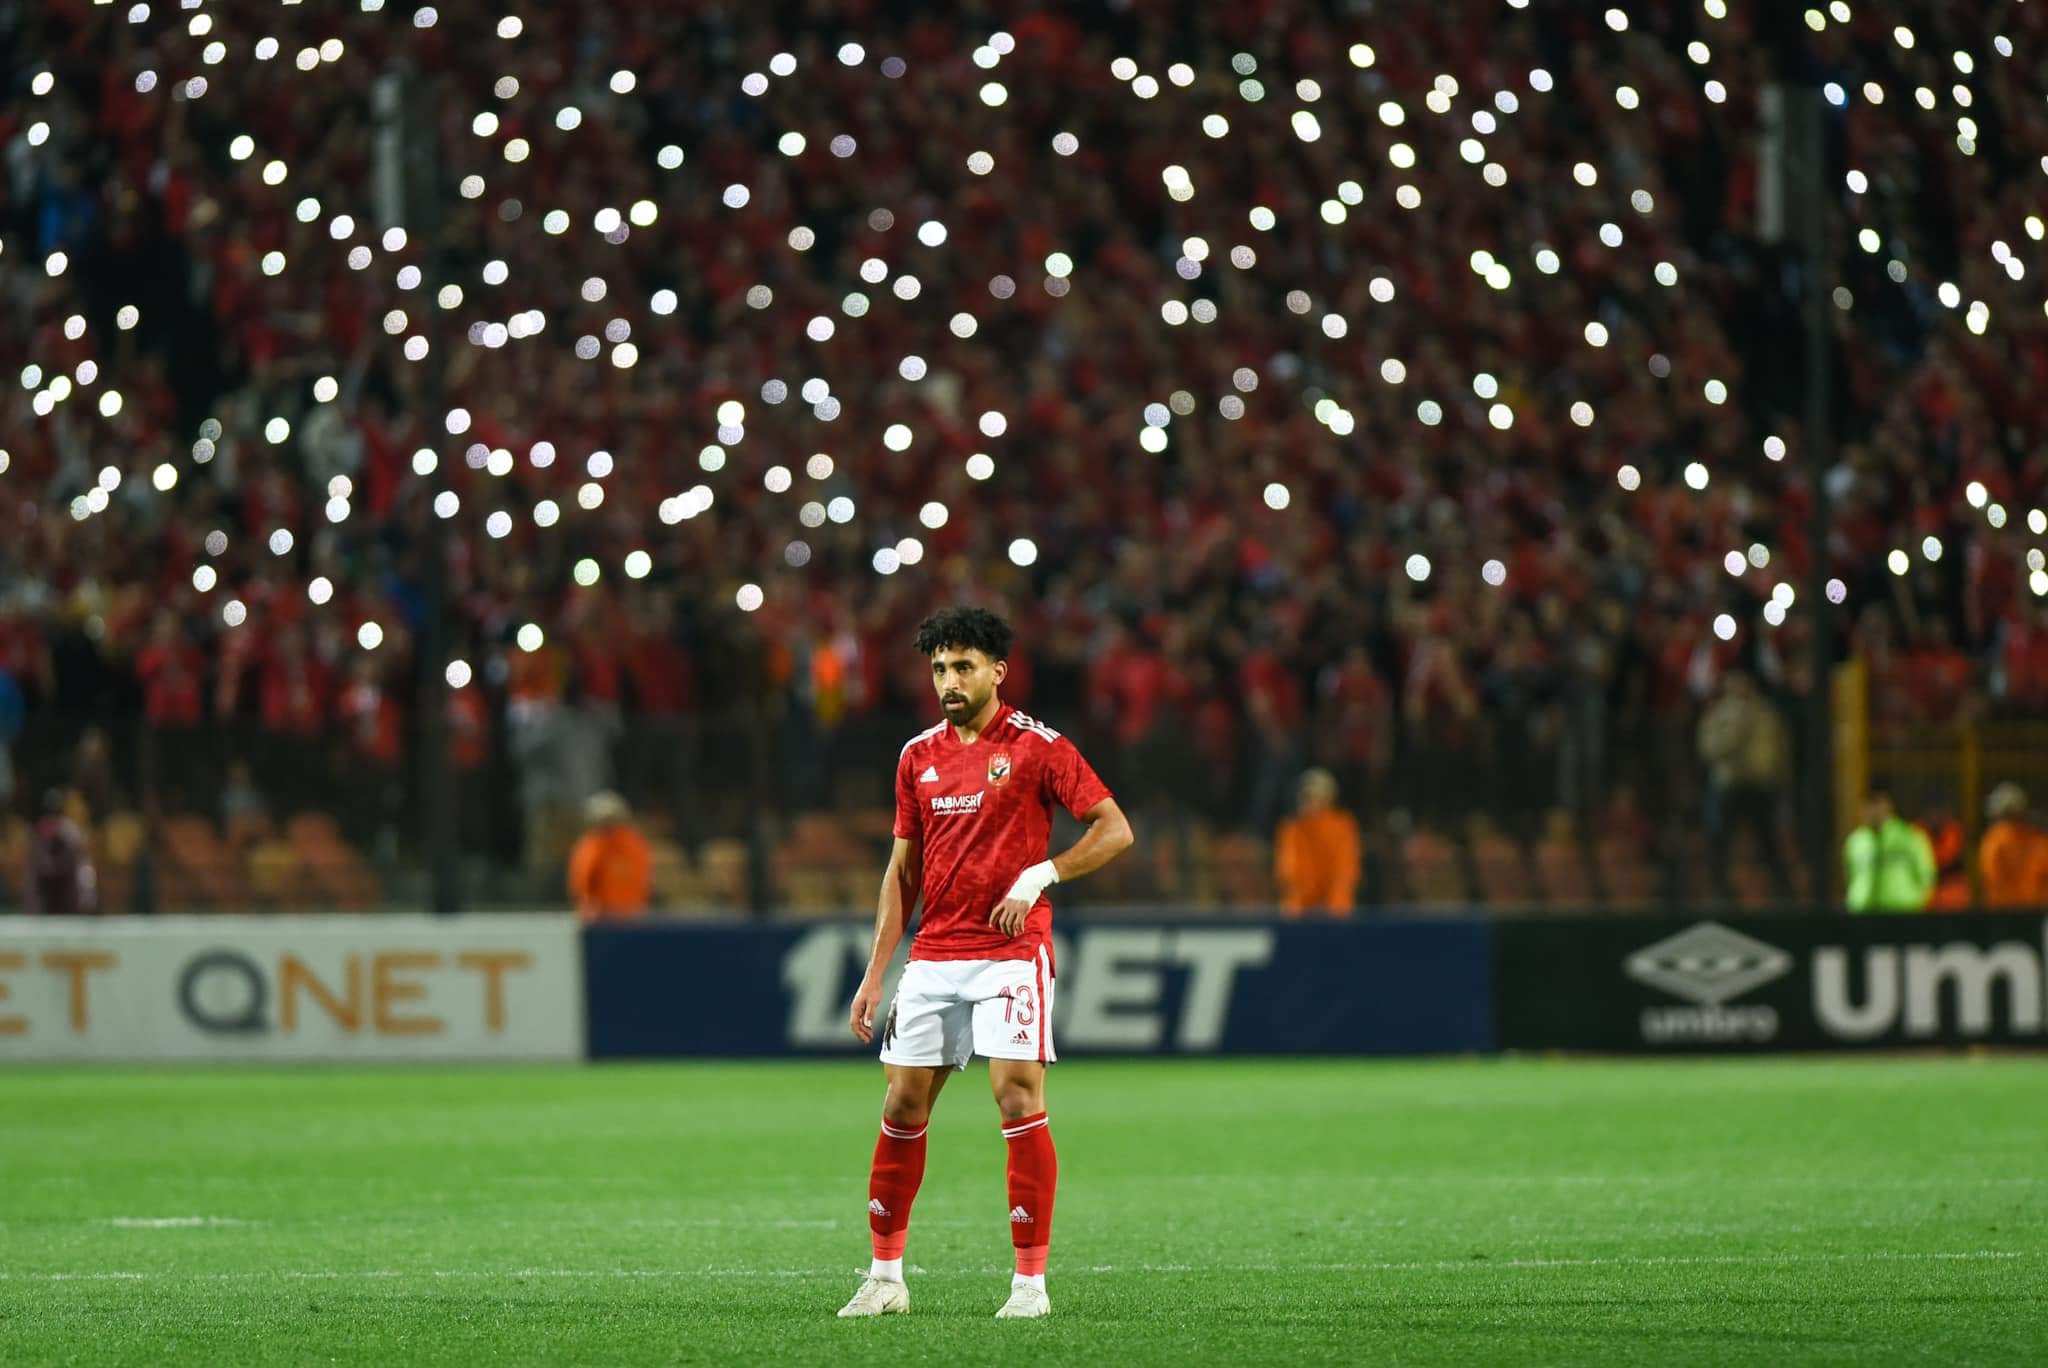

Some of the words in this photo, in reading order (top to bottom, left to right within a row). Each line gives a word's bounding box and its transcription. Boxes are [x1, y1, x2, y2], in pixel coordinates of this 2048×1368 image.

[931, 795, 977, 810] FABMISR
[177, 948, 532, 1036] QNET
[781, 927, 1272, 1046] 1ET
[999, 985, 1034, 1025] 13
[1812, 915, 2048, 1039] um
